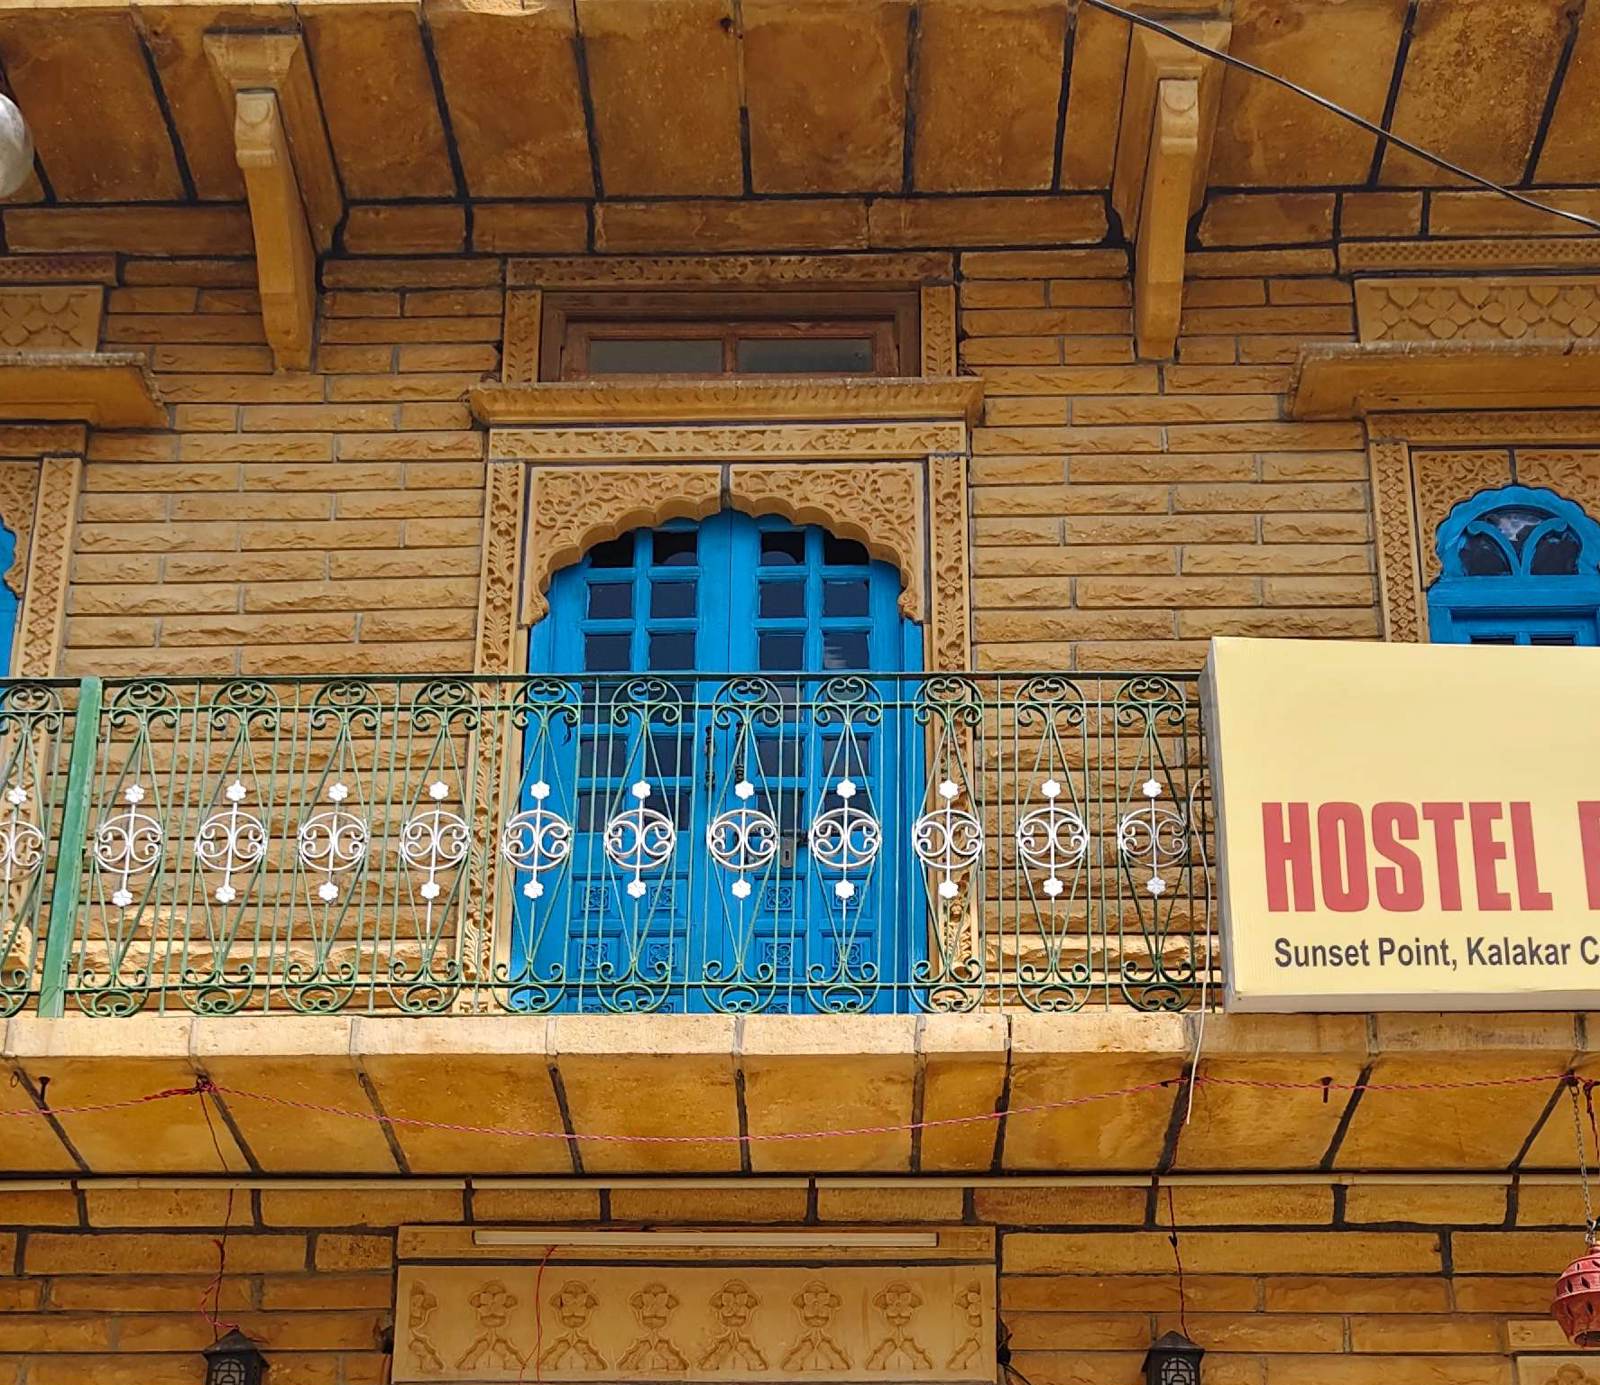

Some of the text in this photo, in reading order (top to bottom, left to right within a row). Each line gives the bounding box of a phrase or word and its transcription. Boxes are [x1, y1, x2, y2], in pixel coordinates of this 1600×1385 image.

[1261, 801, 1553, 913] HOSTEL
[1274, 937, 1371, 967] Sunset
[1378, 937, 1457, 971] Point,
[1466, 936, 1571, 966] Kalakar
